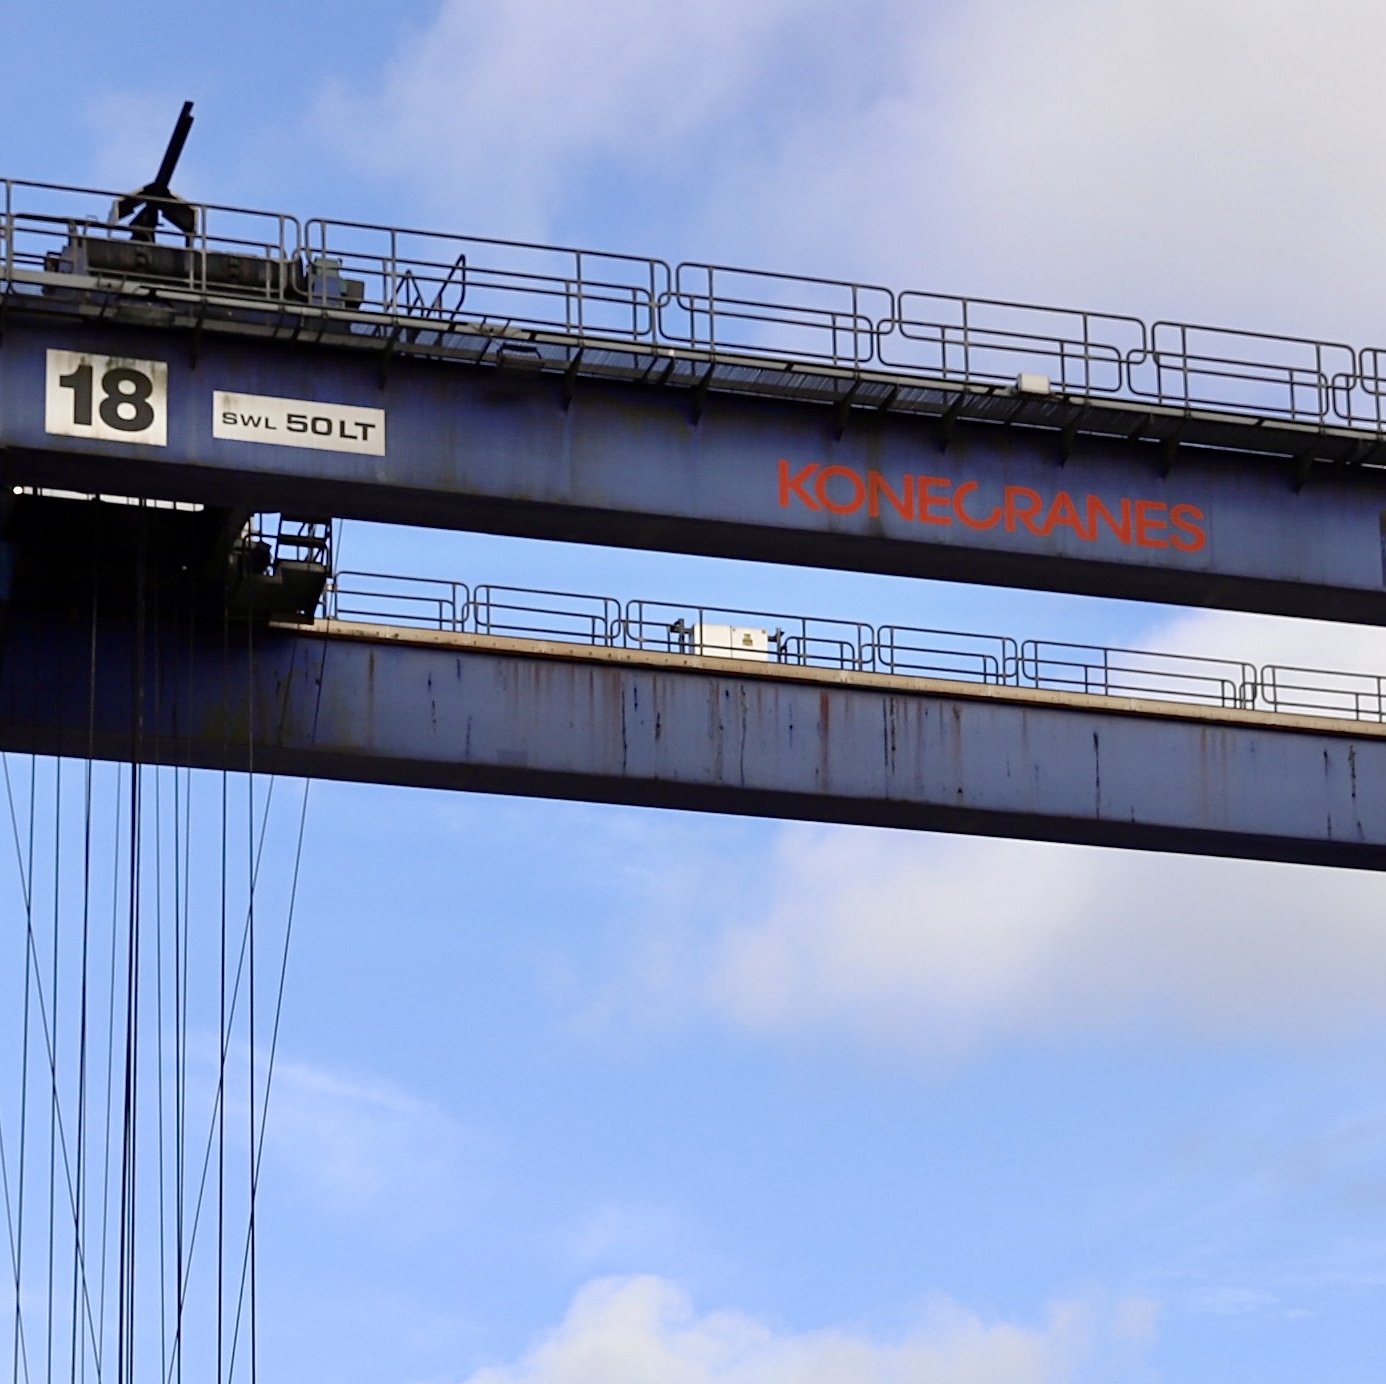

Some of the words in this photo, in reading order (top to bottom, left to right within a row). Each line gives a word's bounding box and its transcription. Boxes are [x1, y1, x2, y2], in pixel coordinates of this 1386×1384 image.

[60, 365, 154, 432] 18
[222, 411, 277, 431] SWL
[777, 459, 1206, 552] KONECRANES
